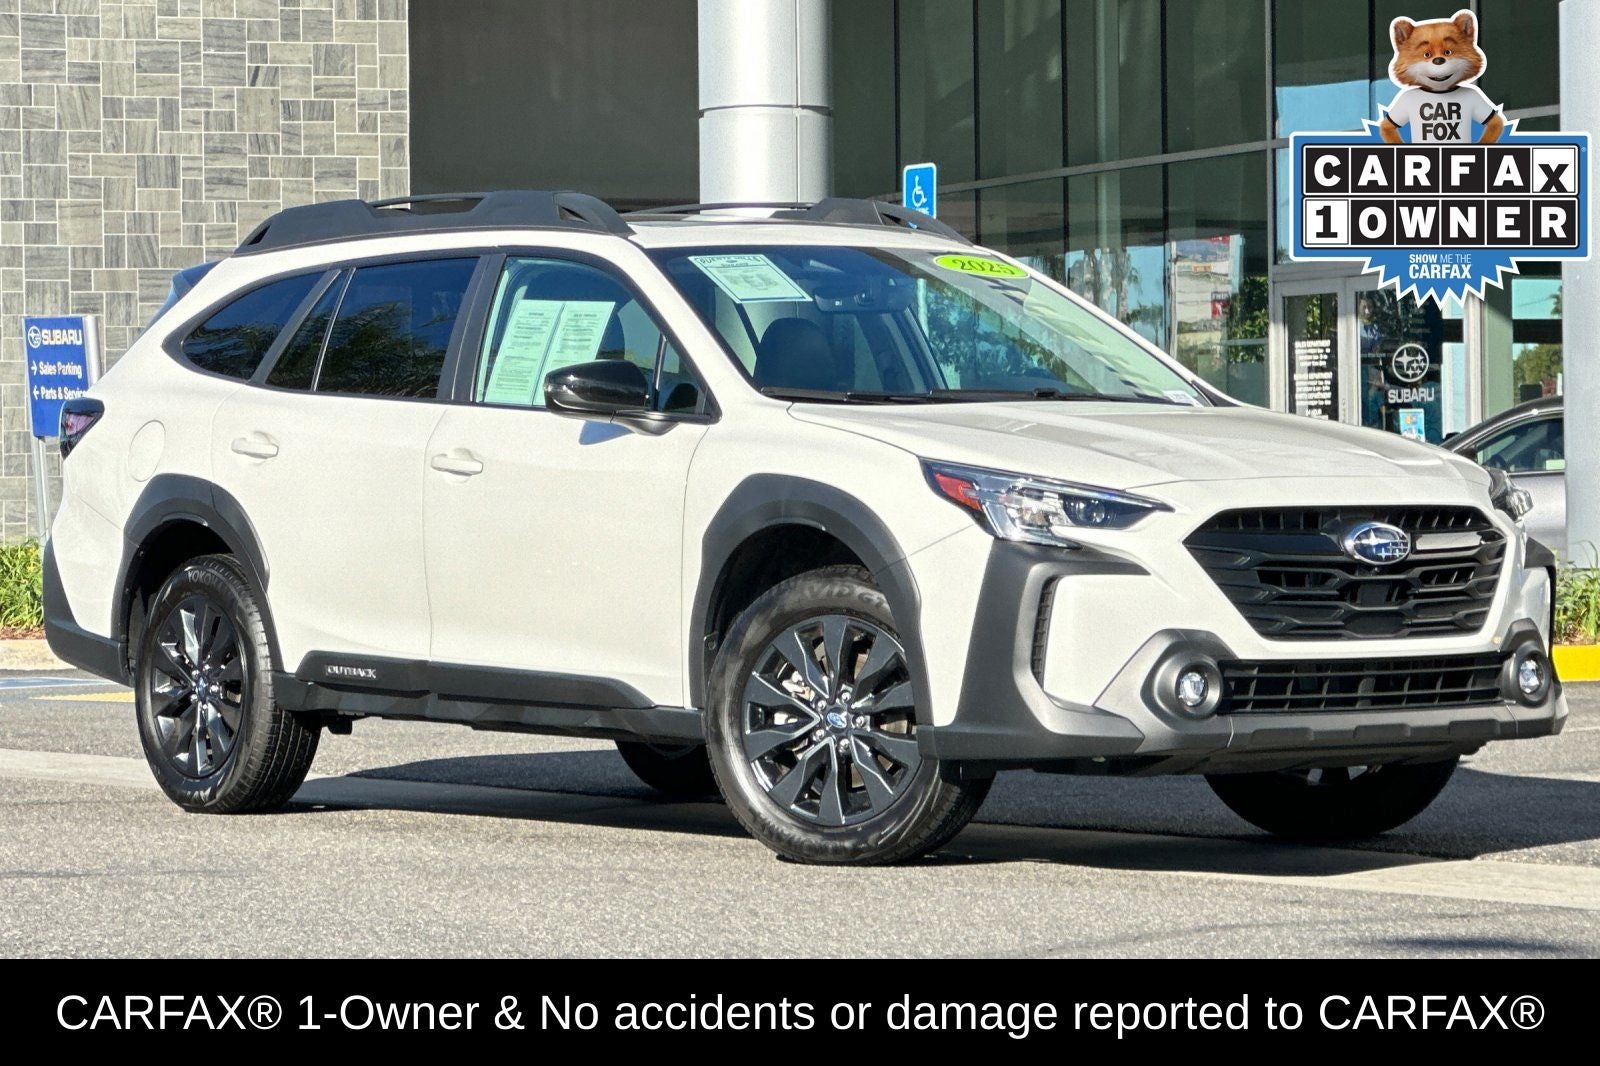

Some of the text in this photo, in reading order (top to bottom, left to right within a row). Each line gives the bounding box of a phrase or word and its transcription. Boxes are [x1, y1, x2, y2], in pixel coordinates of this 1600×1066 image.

[952, 259, 1015, 275] 2025
[42, 329, 82, 345] SUBARU
[39, 361, 82, 379] Sales Parking
[41, 386, 57, 400] Parts
[58, 387, 63, 400] &
[1388, 387, 1435, 403] SUBARU
[327, 664, 377, 679] OUTBACK
